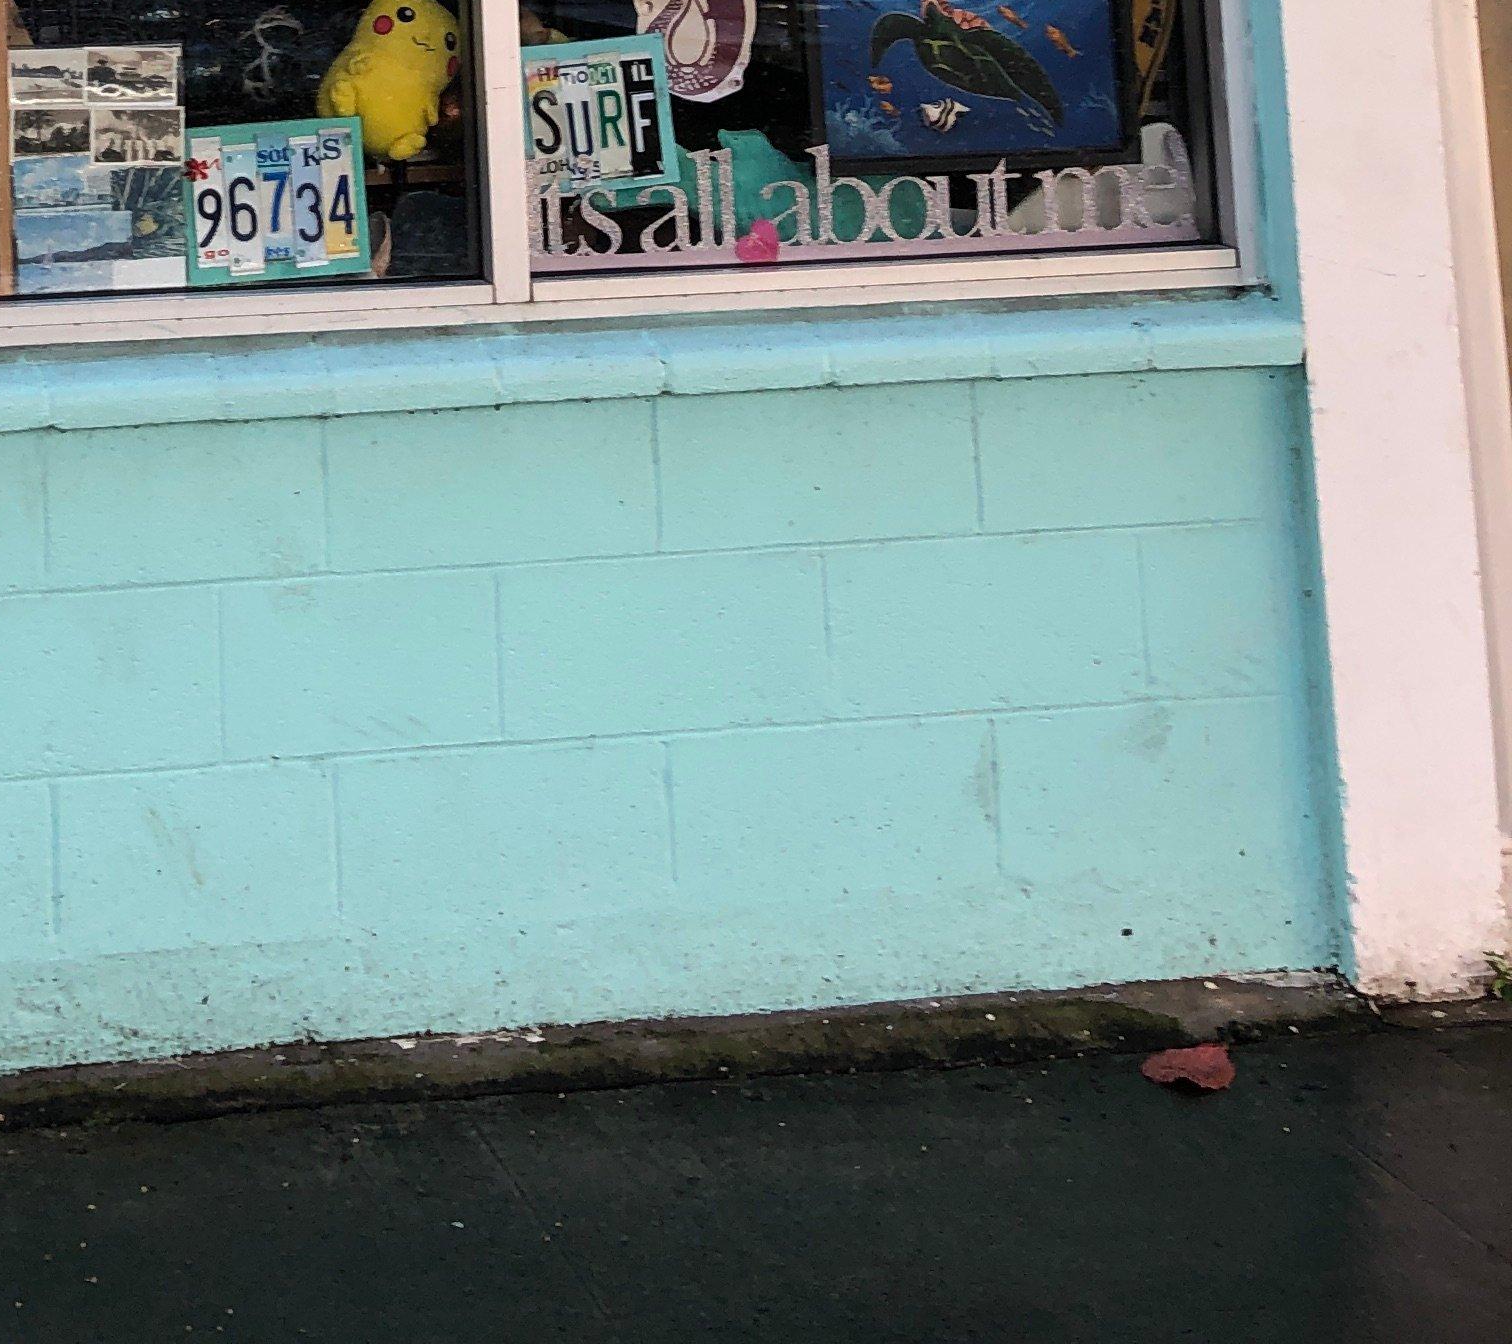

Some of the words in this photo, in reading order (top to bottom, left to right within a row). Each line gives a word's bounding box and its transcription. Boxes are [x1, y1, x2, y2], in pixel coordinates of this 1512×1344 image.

[532, 89, 656, 157] SURF
[197, 174, 355, 249] 96734
[635, 148, 737, 253] all
[760, 144, 1019, 244] about
